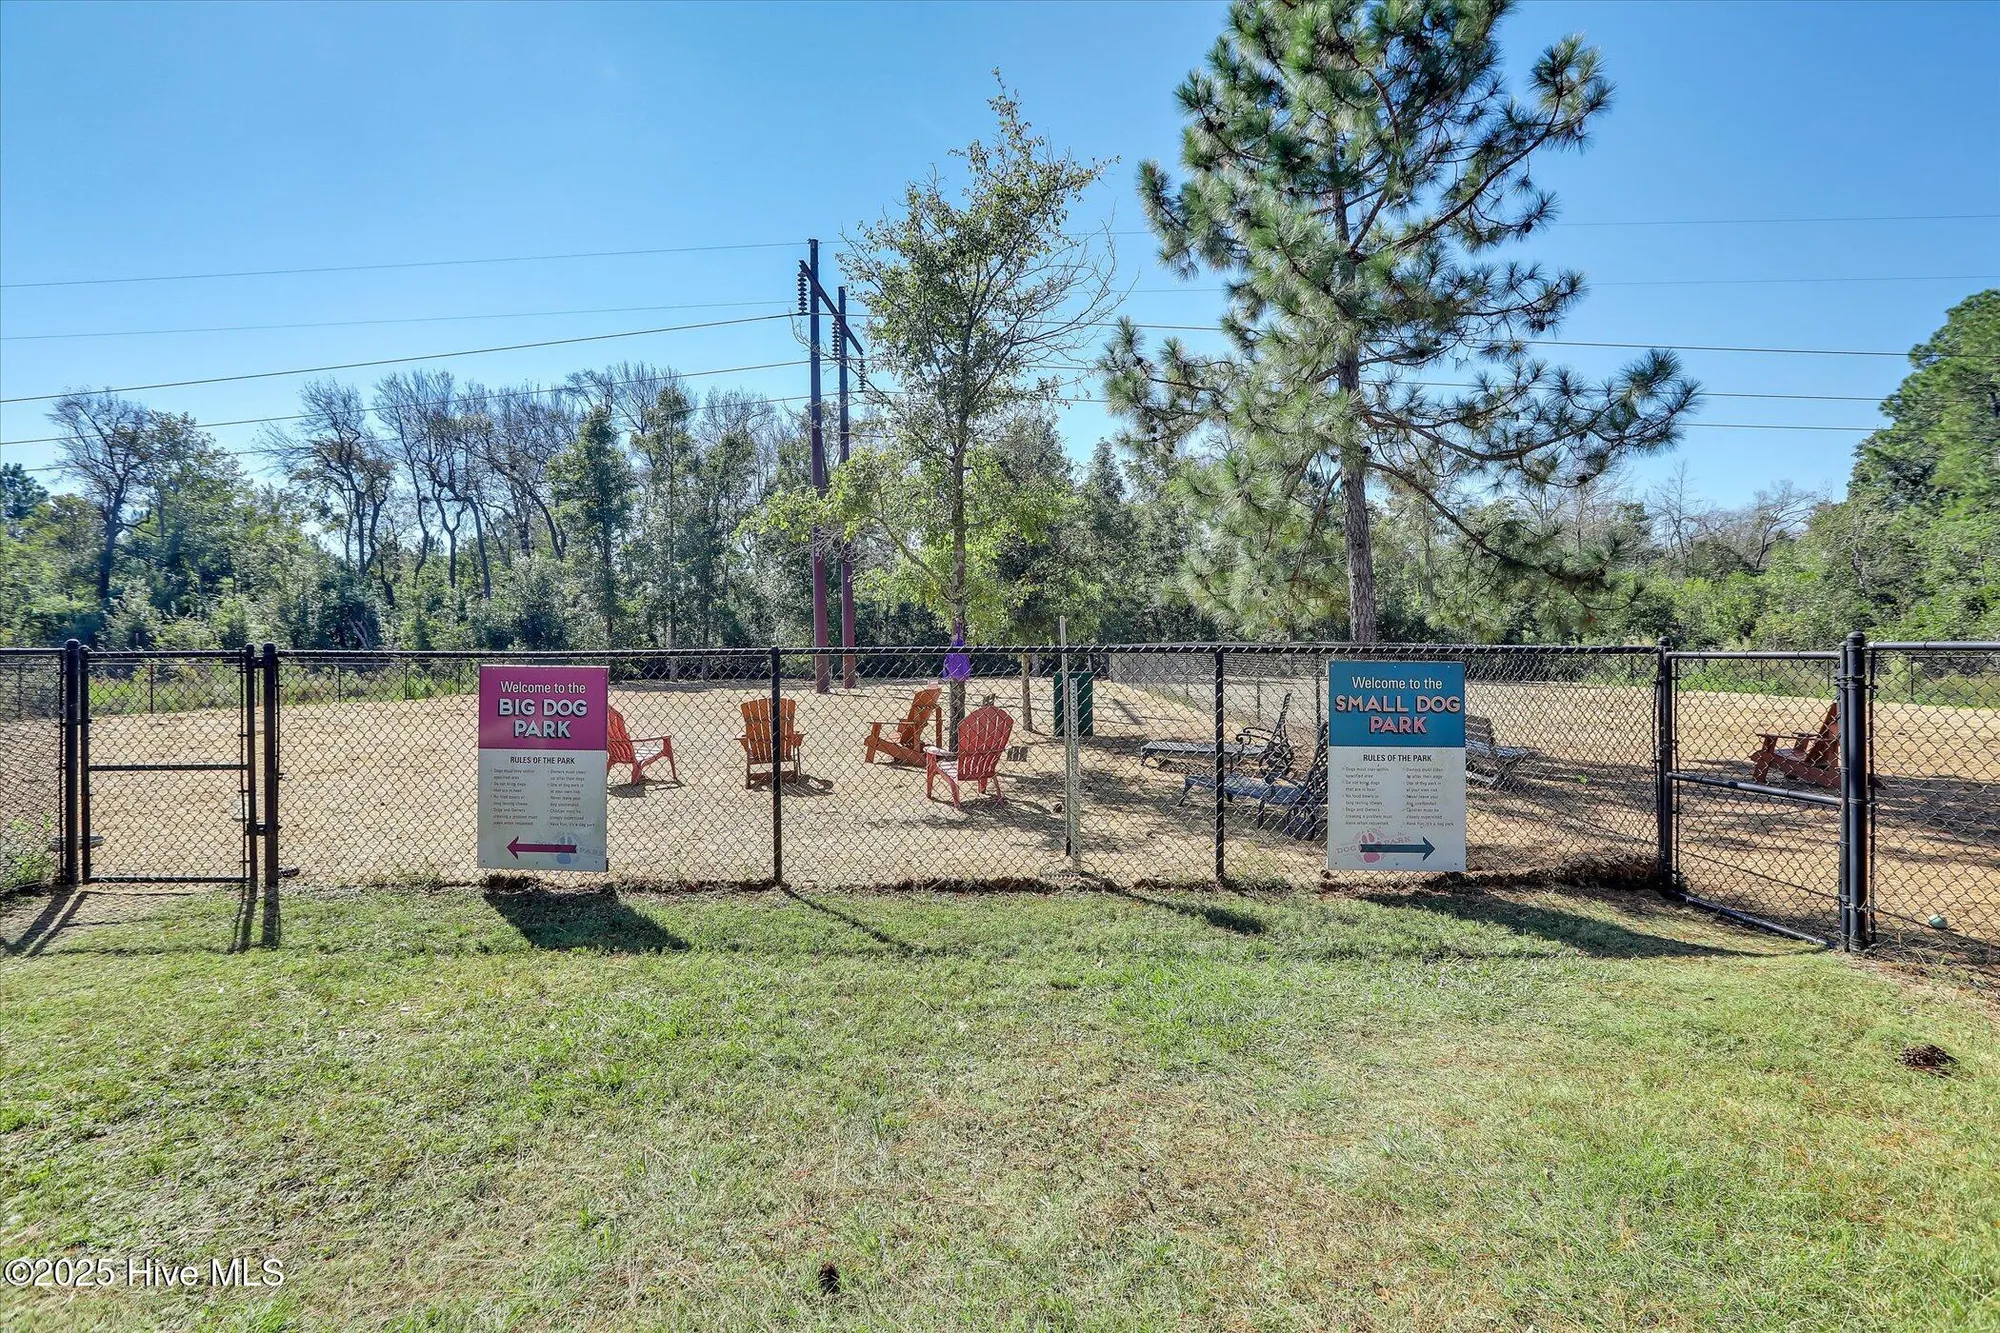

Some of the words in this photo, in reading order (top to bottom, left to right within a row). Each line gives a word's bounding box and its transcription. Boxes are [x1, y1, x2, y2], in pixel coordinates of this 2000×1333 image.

[501, 681, 551, 693] Welcome
[554, 682, 565, 693] to
[568, 682, 586, 693] the
[1352, 676, 1405, 689] Welcome
[1409, 677, 1420, 689] to
[1424, 677, 1442, 689] the
[499, 699, 535, 716] BIG
[543, 699, 587, 717] DOG
[1336, 695, 1409, 713] SMALL
[1416, 696, 1460, 713] DOG
[514, 721, 571, 738] PARK
[1369, 717, 1427, 734] PARK
